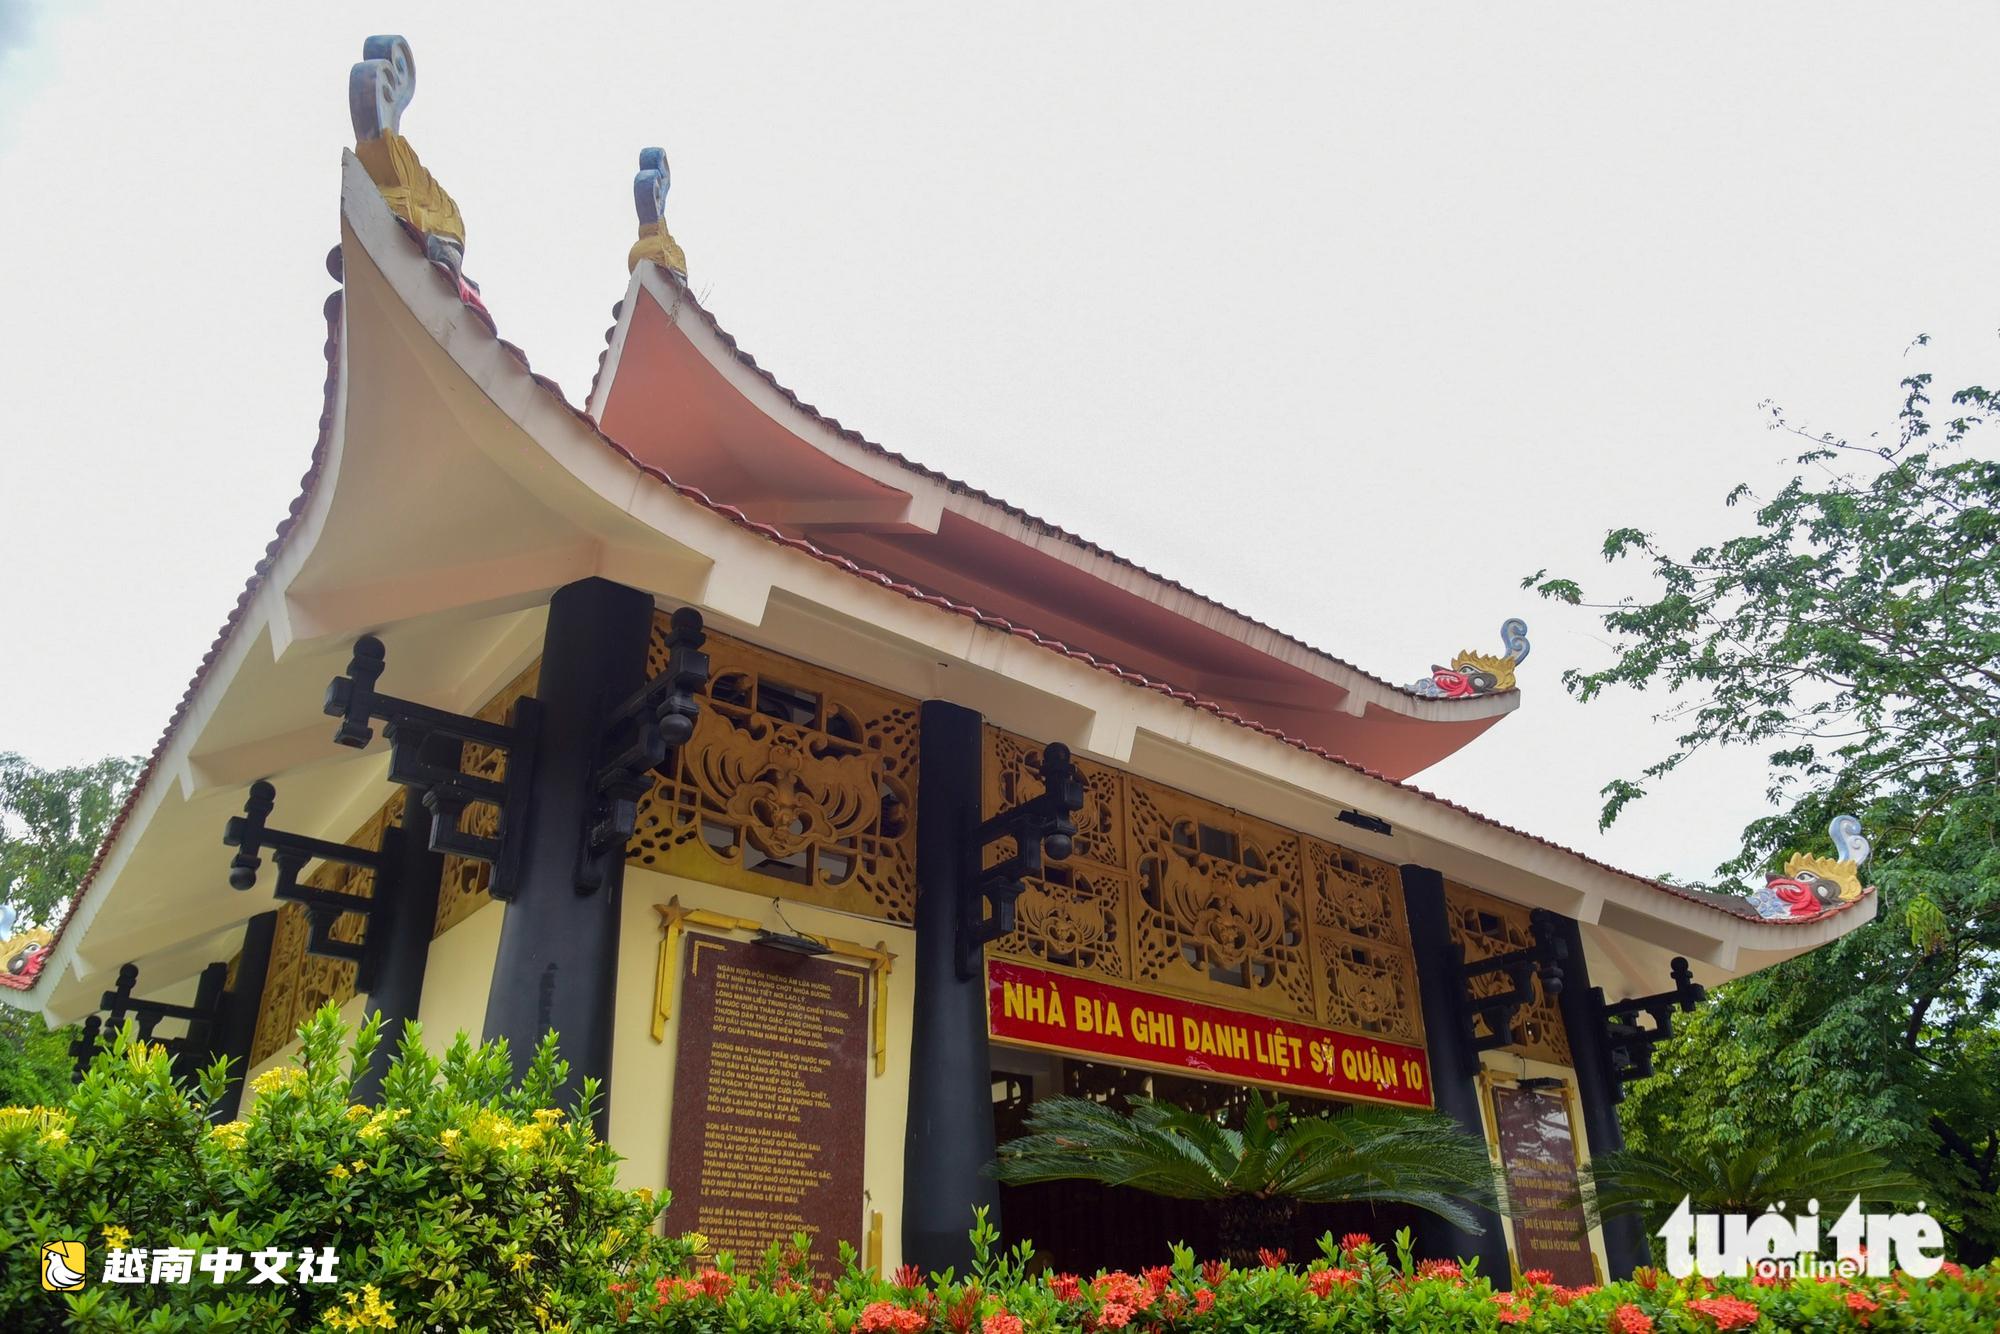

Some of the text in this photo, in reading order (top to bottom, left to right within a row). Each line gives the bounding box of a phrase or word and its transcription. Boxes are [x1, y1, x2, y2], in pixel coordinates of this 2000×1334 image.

[1003, 981, 1066, 1028] NHÀ
[1075, 996, 1123, 1037] BIA
[1131, 1008, 1175, 1048] GHI
[1182, 1017, 1250, 1060] DANH
[1255, 1027, 1303, 1075] LIỆT
[1341, 1046, 1398, 1091] QUẬN
[1402, 1060, 1422, 1090] 10
